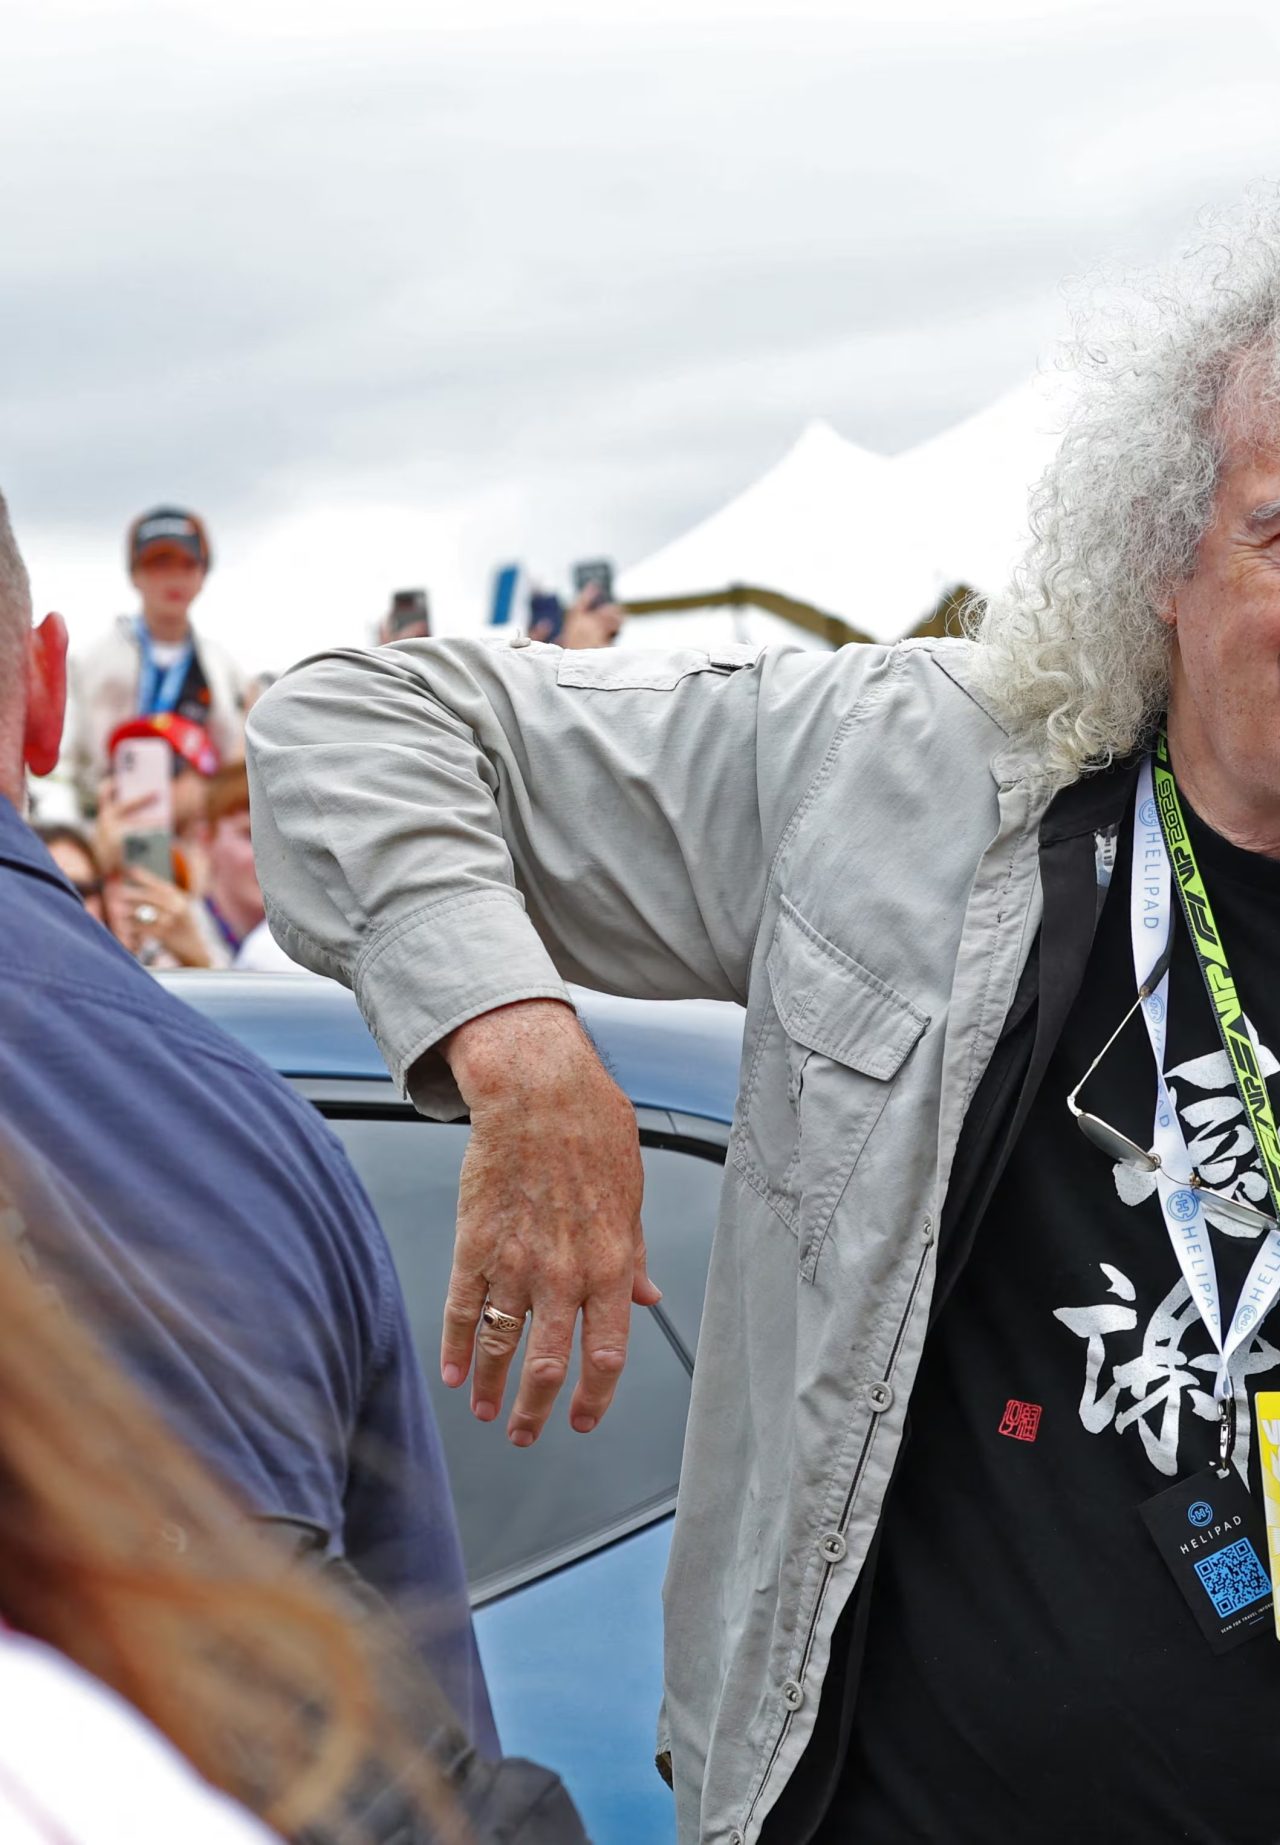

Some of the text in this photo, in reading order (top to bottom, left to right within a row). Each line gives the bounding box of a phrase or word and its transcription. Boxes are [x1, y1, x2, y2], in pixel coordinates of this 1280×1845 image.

[1157, 778, 1186, 846] 2026
[1143, 831, 1162, 930] HELIPAD
[1173, 846, 1196, 887] VIP
[1205, 963, 1243, 1028] VIP
[1242, 1076, 1266, 1117] VIP
[1180, 1226, 1219, 1326] HELIPAD
[1179, 1515, 1242, 1555] HELIPAD
